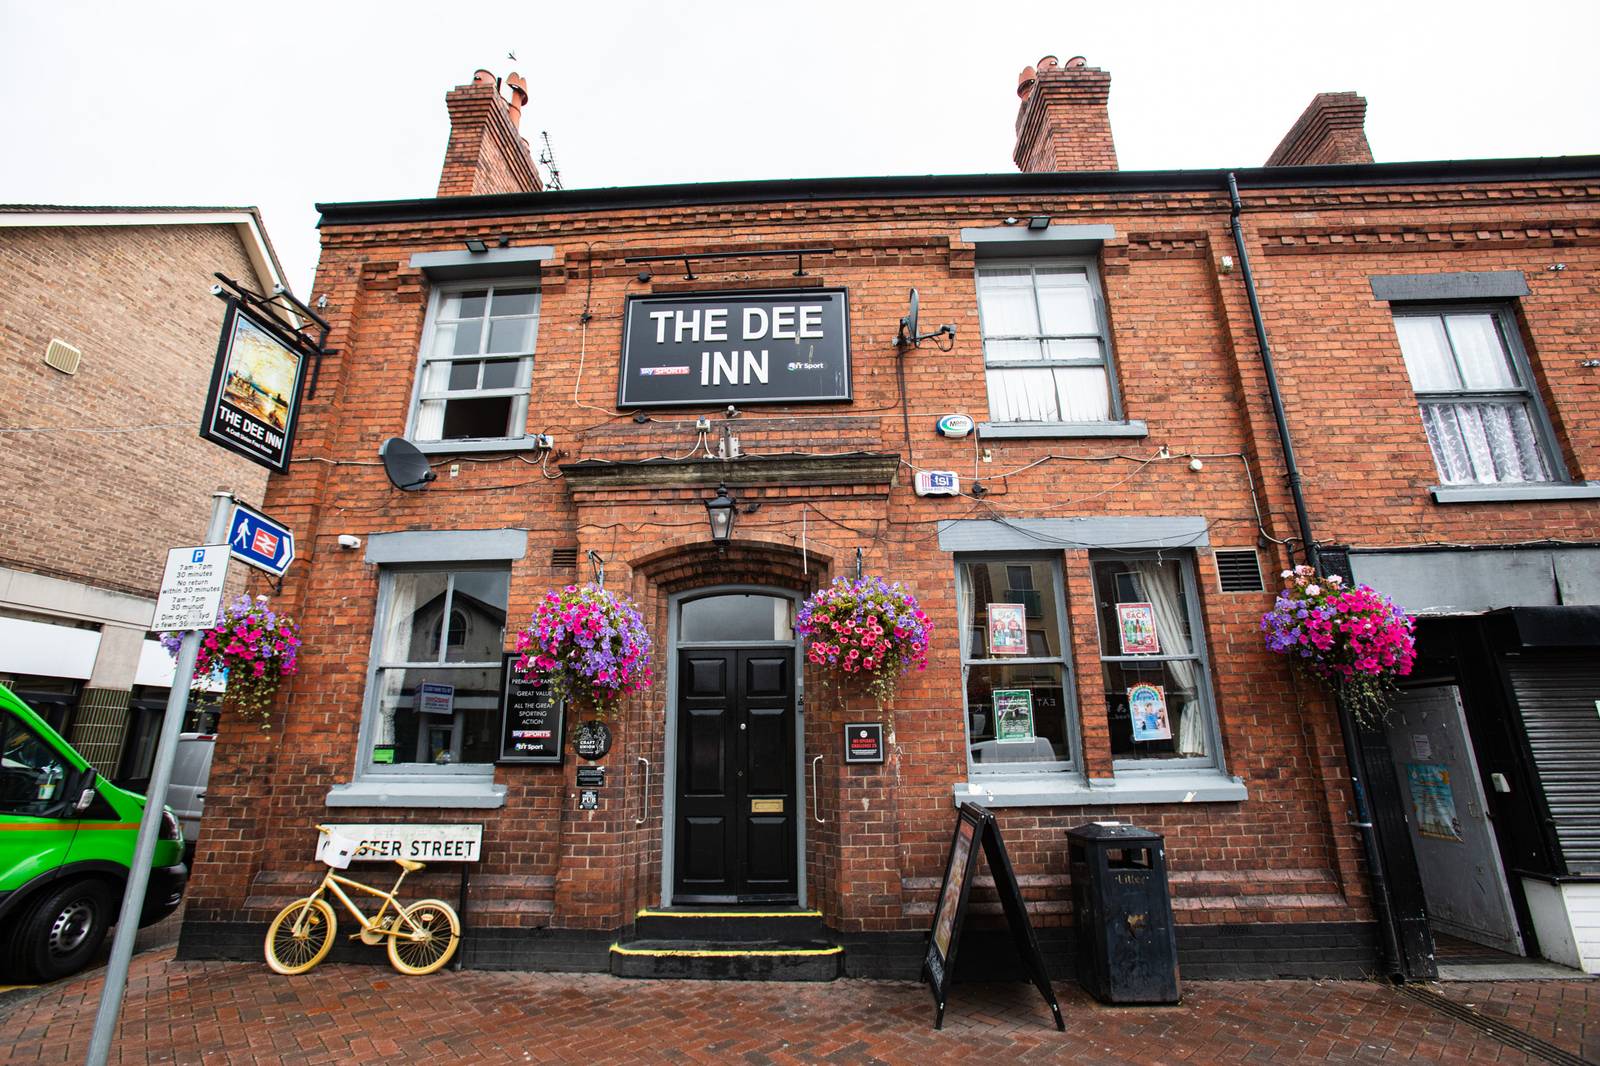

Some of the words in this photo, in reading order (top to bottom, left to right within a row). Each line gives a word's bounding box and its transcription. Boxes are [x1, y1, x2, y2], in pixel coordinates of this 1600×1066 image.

[650, 308, 729, 344] THE
[742, 305, 824, 341] DEE
[655, 366, 690, 376] SPORTS
[701, 350, 769, 386] INN
[804, 362, 824, 370] Sport
[220, 405, 242, 428] THE
[243, 418, 265, 440] DEE
[265, 431, 283, 450] INN
[195, 550, 204, 561] P
[175, 612, 210, 621] dyclyd
[411, 840, 475, 856] STREET
